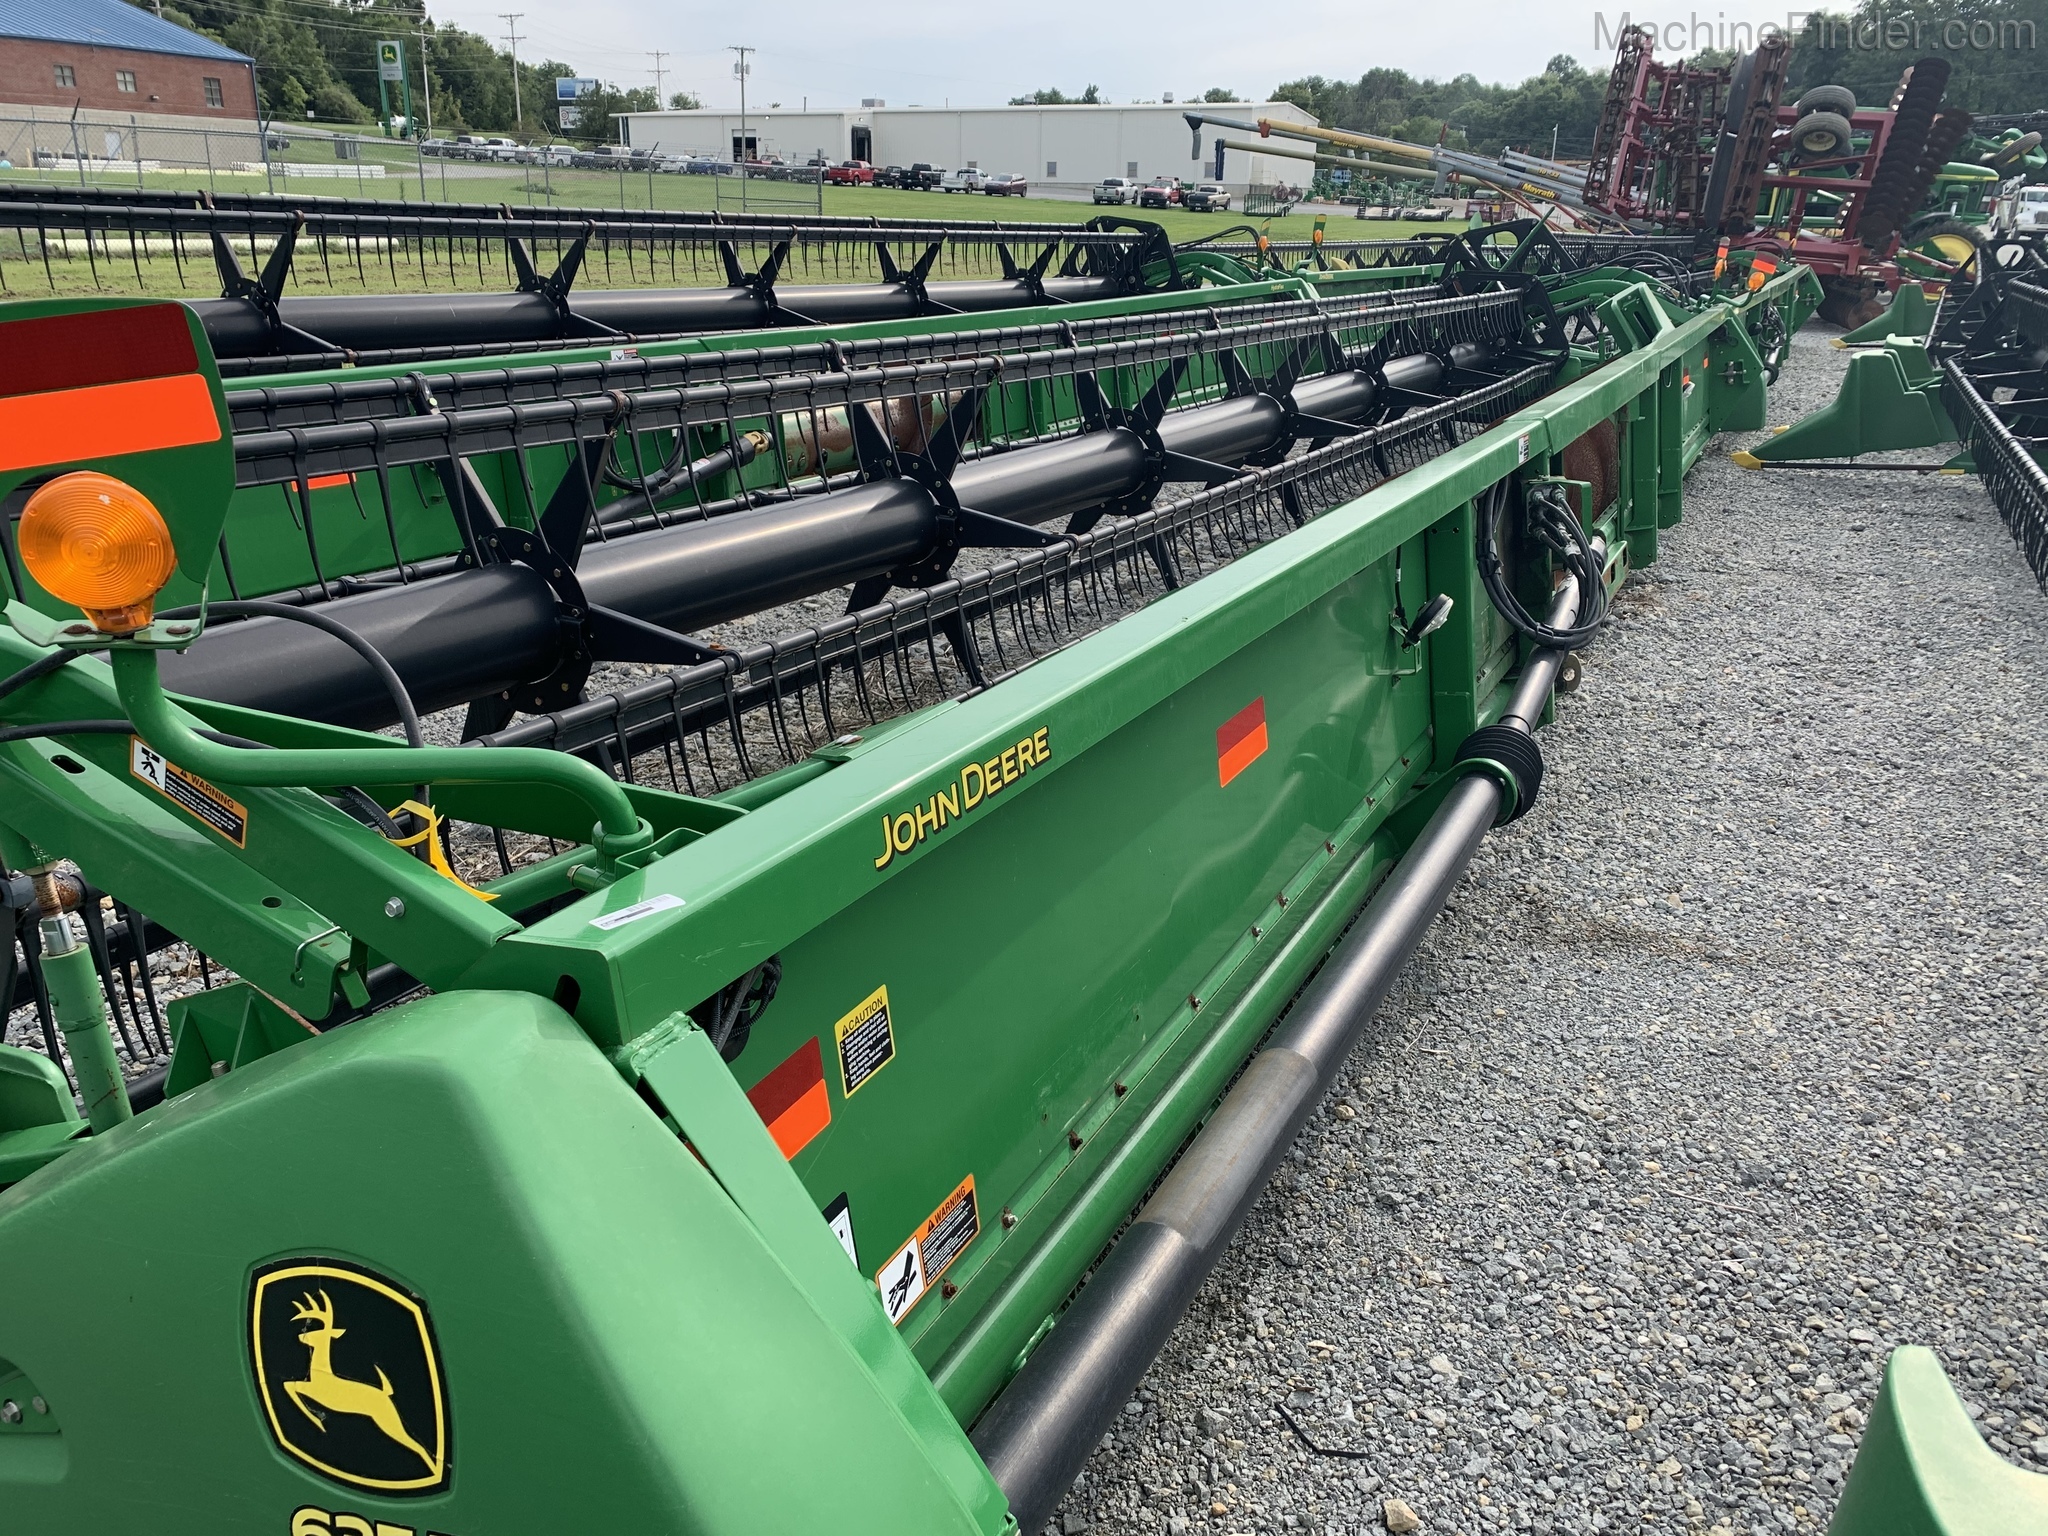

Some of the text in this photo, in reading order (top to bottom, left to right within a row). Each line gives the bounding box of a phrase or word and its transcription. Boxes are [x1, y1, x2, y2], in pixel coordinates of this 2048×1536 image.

[1522, 182, 1555, 199] Mayrath
[191, 774, 234, 809] WARNING
[874, 725, 1051, 869] JOHN DEERE
[848, 996, 883, 1031] CAUTION
[935, 1185, 966, 1223] WARNING
